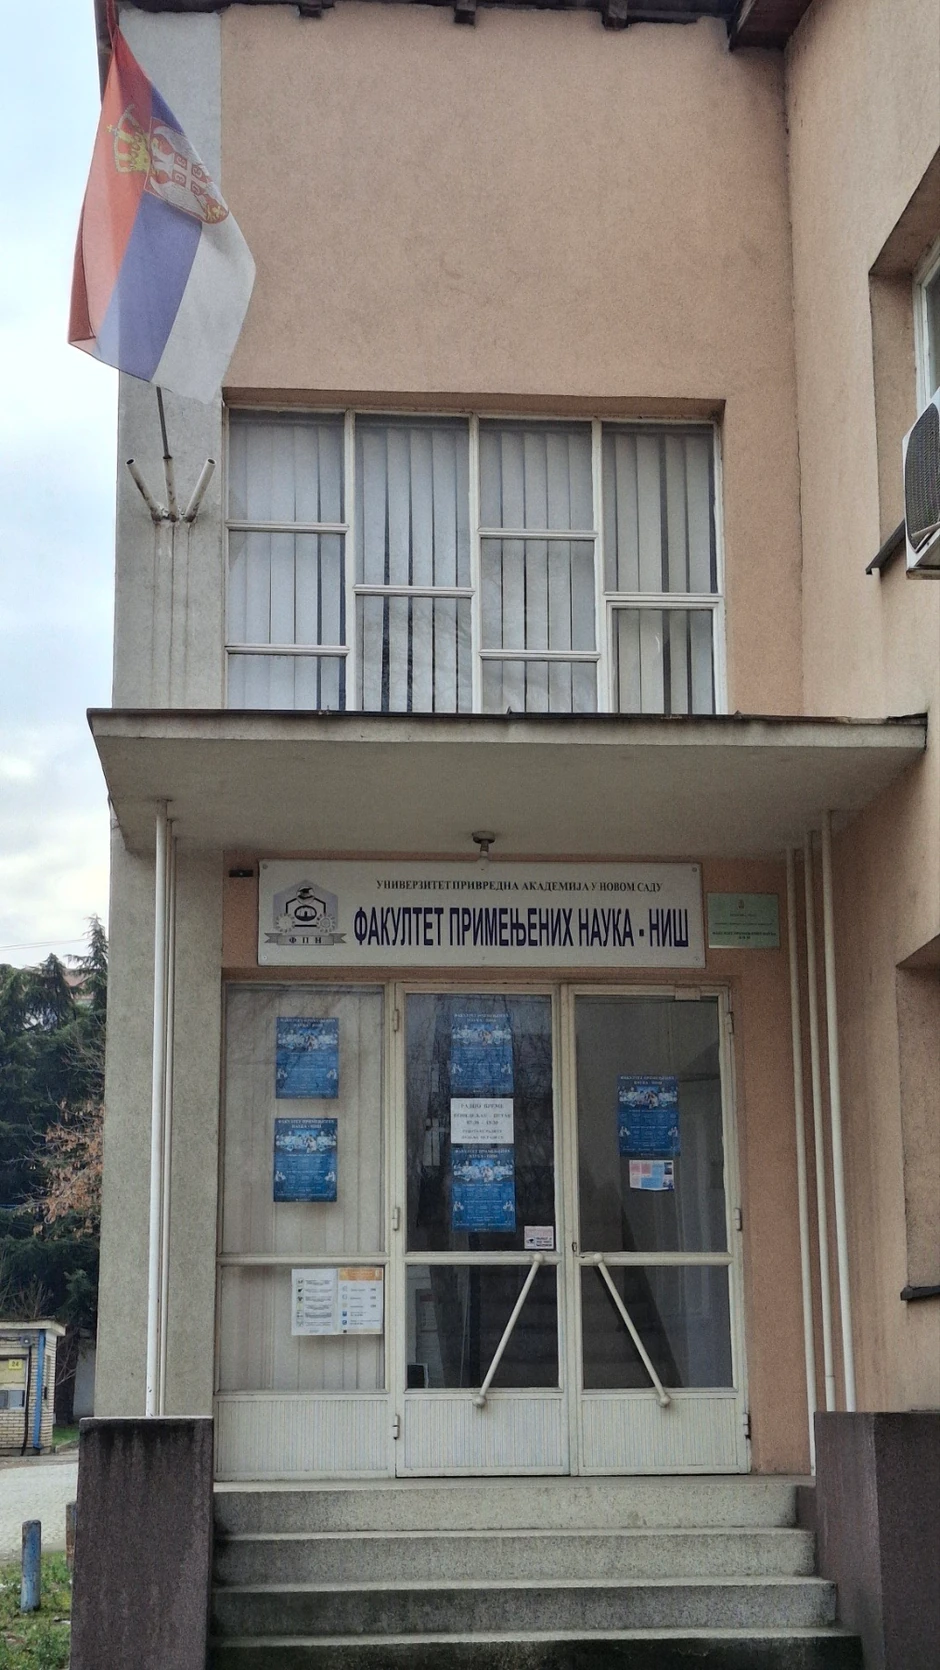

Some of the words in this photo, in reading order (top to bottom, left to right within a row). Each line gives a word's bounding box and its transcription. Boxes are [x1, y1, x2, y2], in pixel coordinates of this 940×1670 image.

[376, 880, 452, 890] УНИВЕРЗИТЕТ
[453, 881, 519, 891] ПРИВРЕДНА
[521, 881, 589, 892] АКАДЕМИЈА
[591, 882, 599, 891] У
[600, 882, 635, 892] НОВОМ
[637, 883, 663, 893] САДУ
[354, 906, 444, 946] ФАКУЛТЕТ
[449, 907, 574, 947] ПРИМЕЊЕНИХ
[578, 908, 635, 947] НАУКА
[648, 908, 689, 947] НИШ
